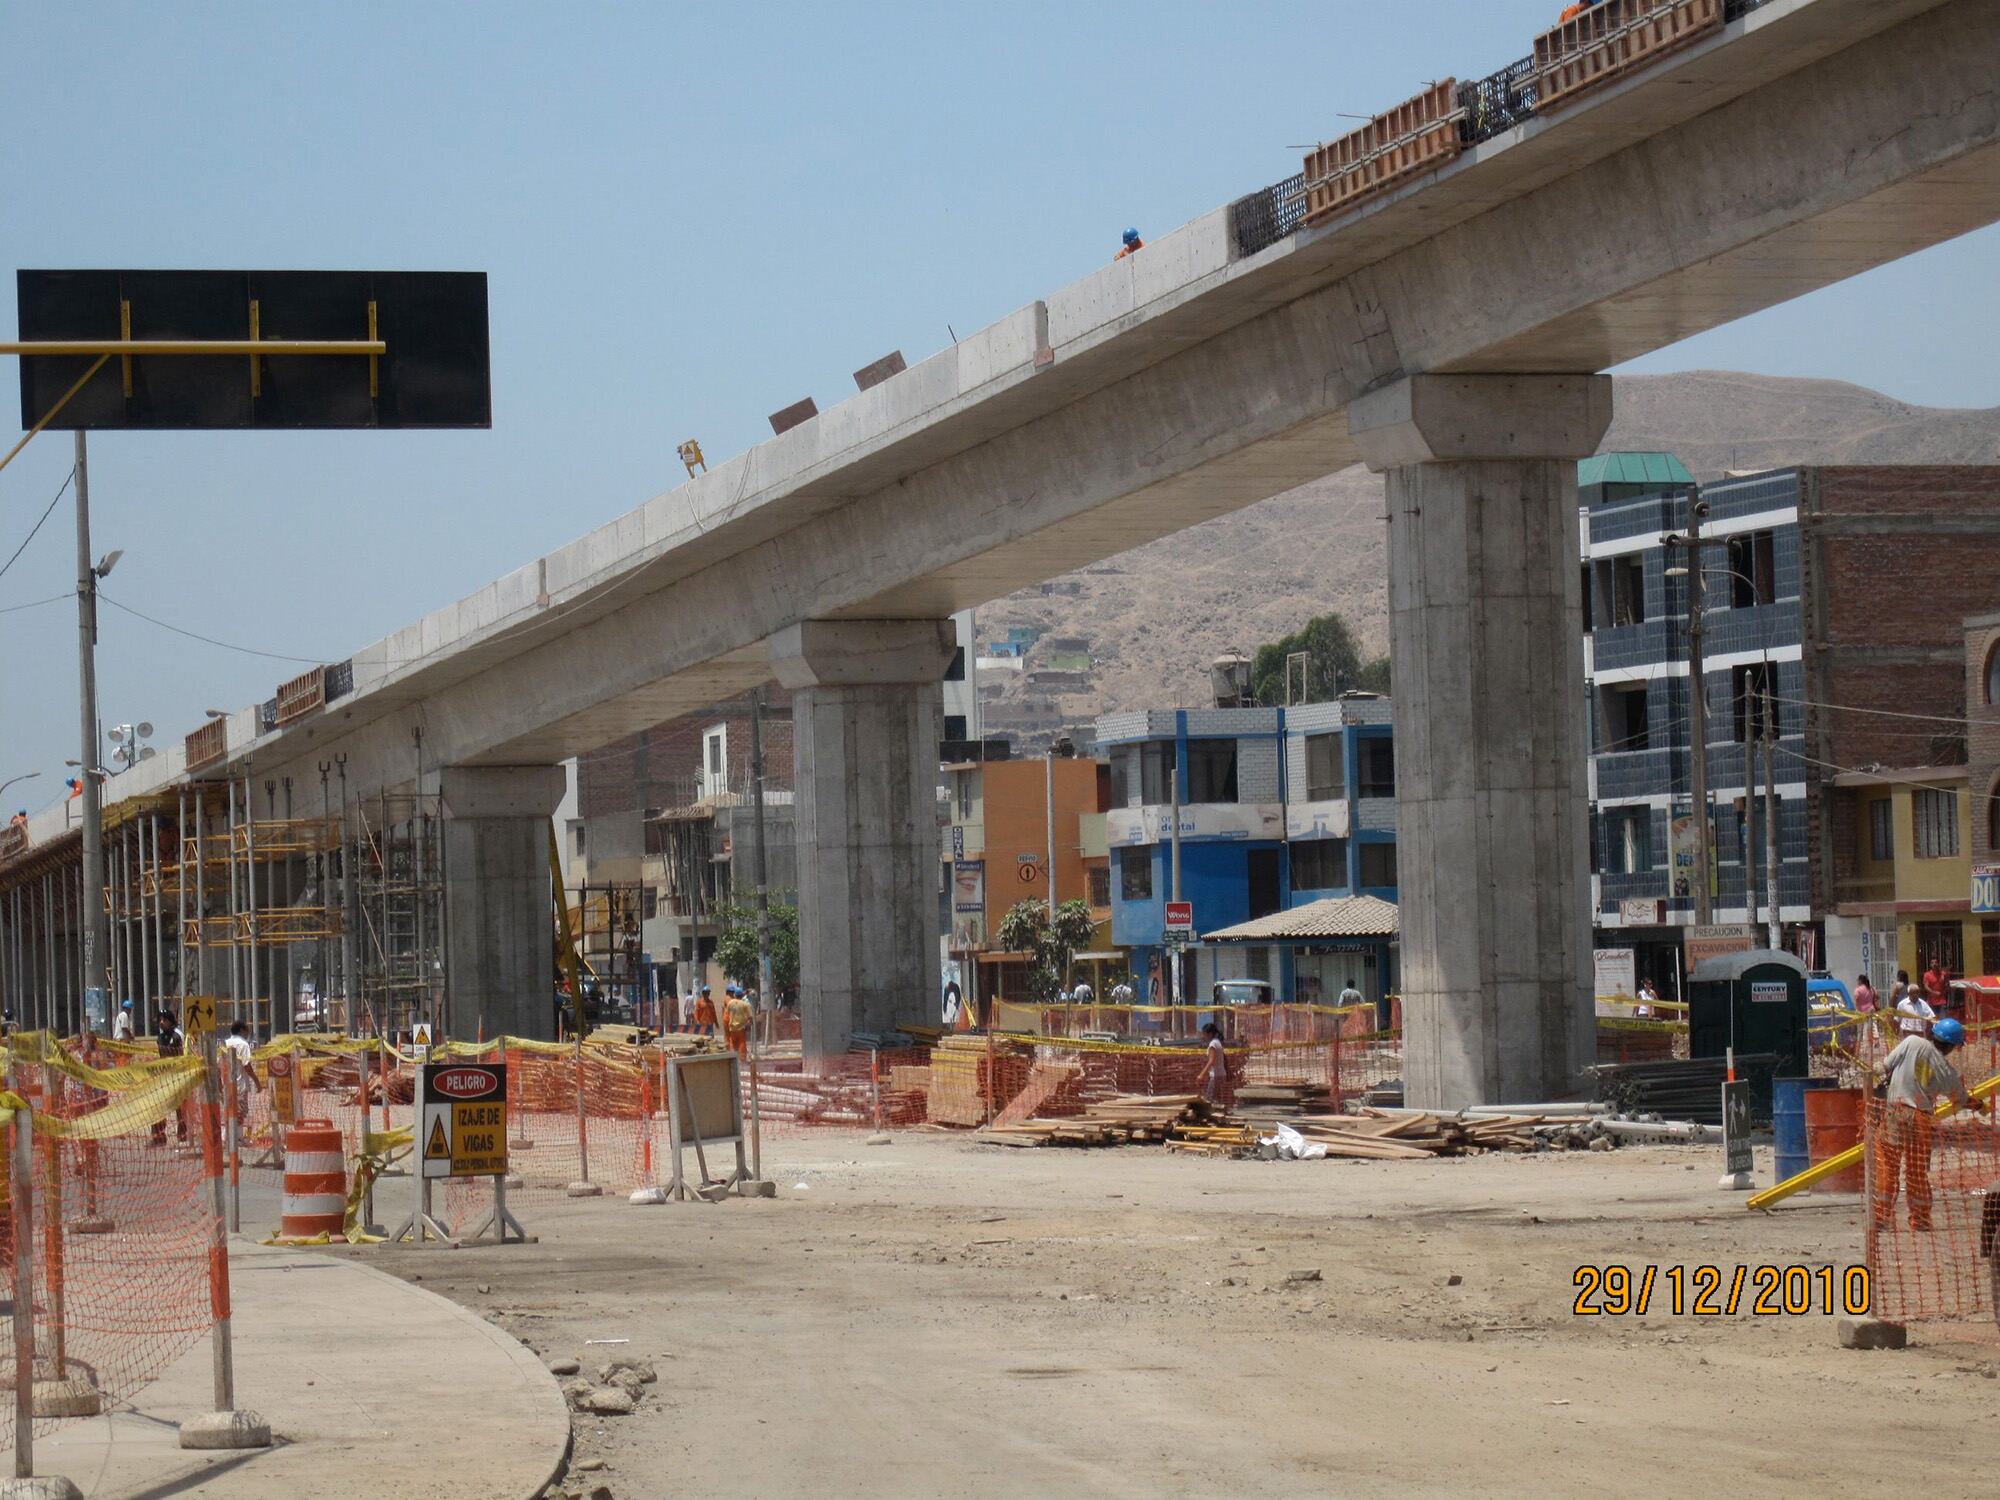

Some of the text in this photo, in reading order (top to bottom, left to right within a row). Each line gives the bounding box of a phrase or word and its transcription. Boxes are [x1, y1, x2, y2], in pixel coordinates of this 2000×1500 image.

[1161, 823, 1195, 832] detal
[953, 827, 963, 860] DENTAL
[1694, 927, 1743, 937] PRECAUCION
[1690, 942, 1748, 953] EXCAVACION
[446, 1075, 486, 1091] PELIGRO
[458, 1107, 501, 1126] IZAJE DE
[463, 1134, 494, 1152] VIGAS
